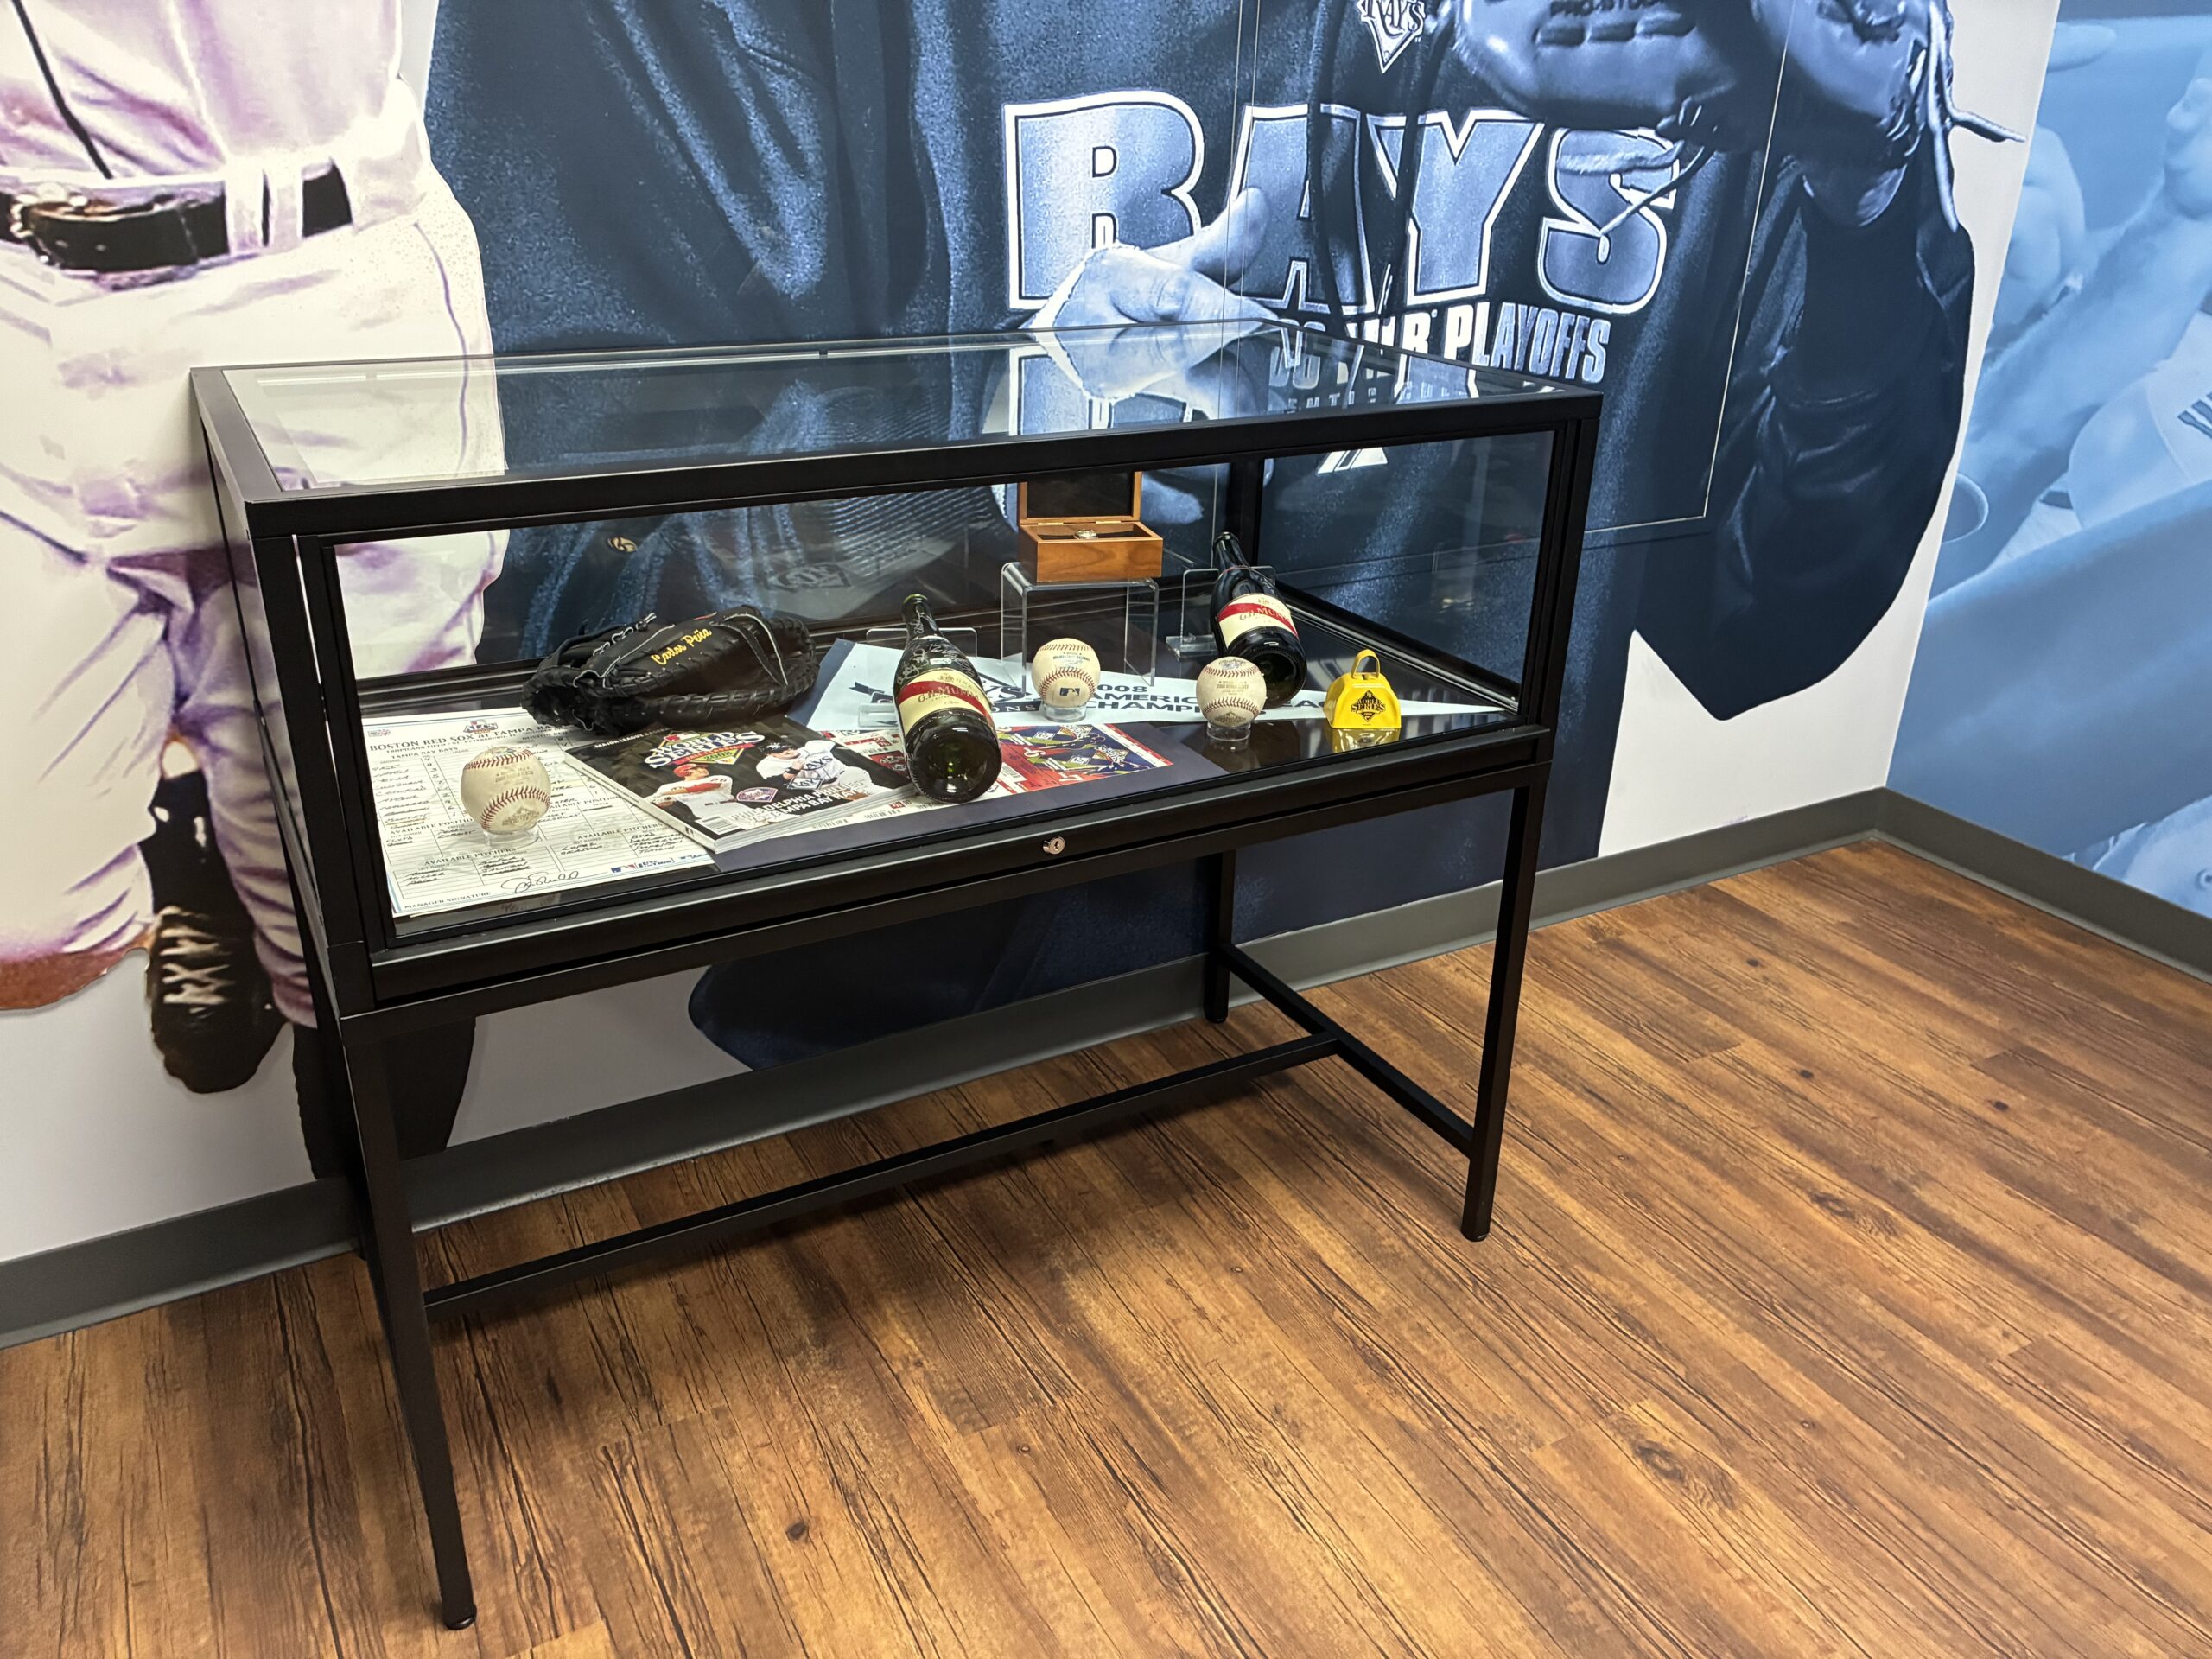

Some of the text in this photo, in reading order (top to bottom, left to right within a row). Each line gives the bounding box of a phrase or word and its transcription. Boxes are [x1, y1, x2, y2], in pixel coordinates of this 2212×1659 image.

[1002, 90, 1680, 316] RAYS
[1443, 302, 1611, 384] PLAYOFFS
[370, 741, 419, 751] BOSTON
[423, 737, 447, 746] RED
[494, 728, 533, 736] TAMPA
[650, 732, 738, 755] WORLD
[645, 731, 765, 768] SERIES
[804, 755, 833, 771] AYS
[550, 800, 583, 810] AILABLE
[438, 817, 474, 827] POSITIO
[577, 823, 663, 840] AVAILABLE PITCHERS
[424, 854, 471, 865] AVAILABLE
[404, 892, 491, 909] MANAGER SIGNATURE
